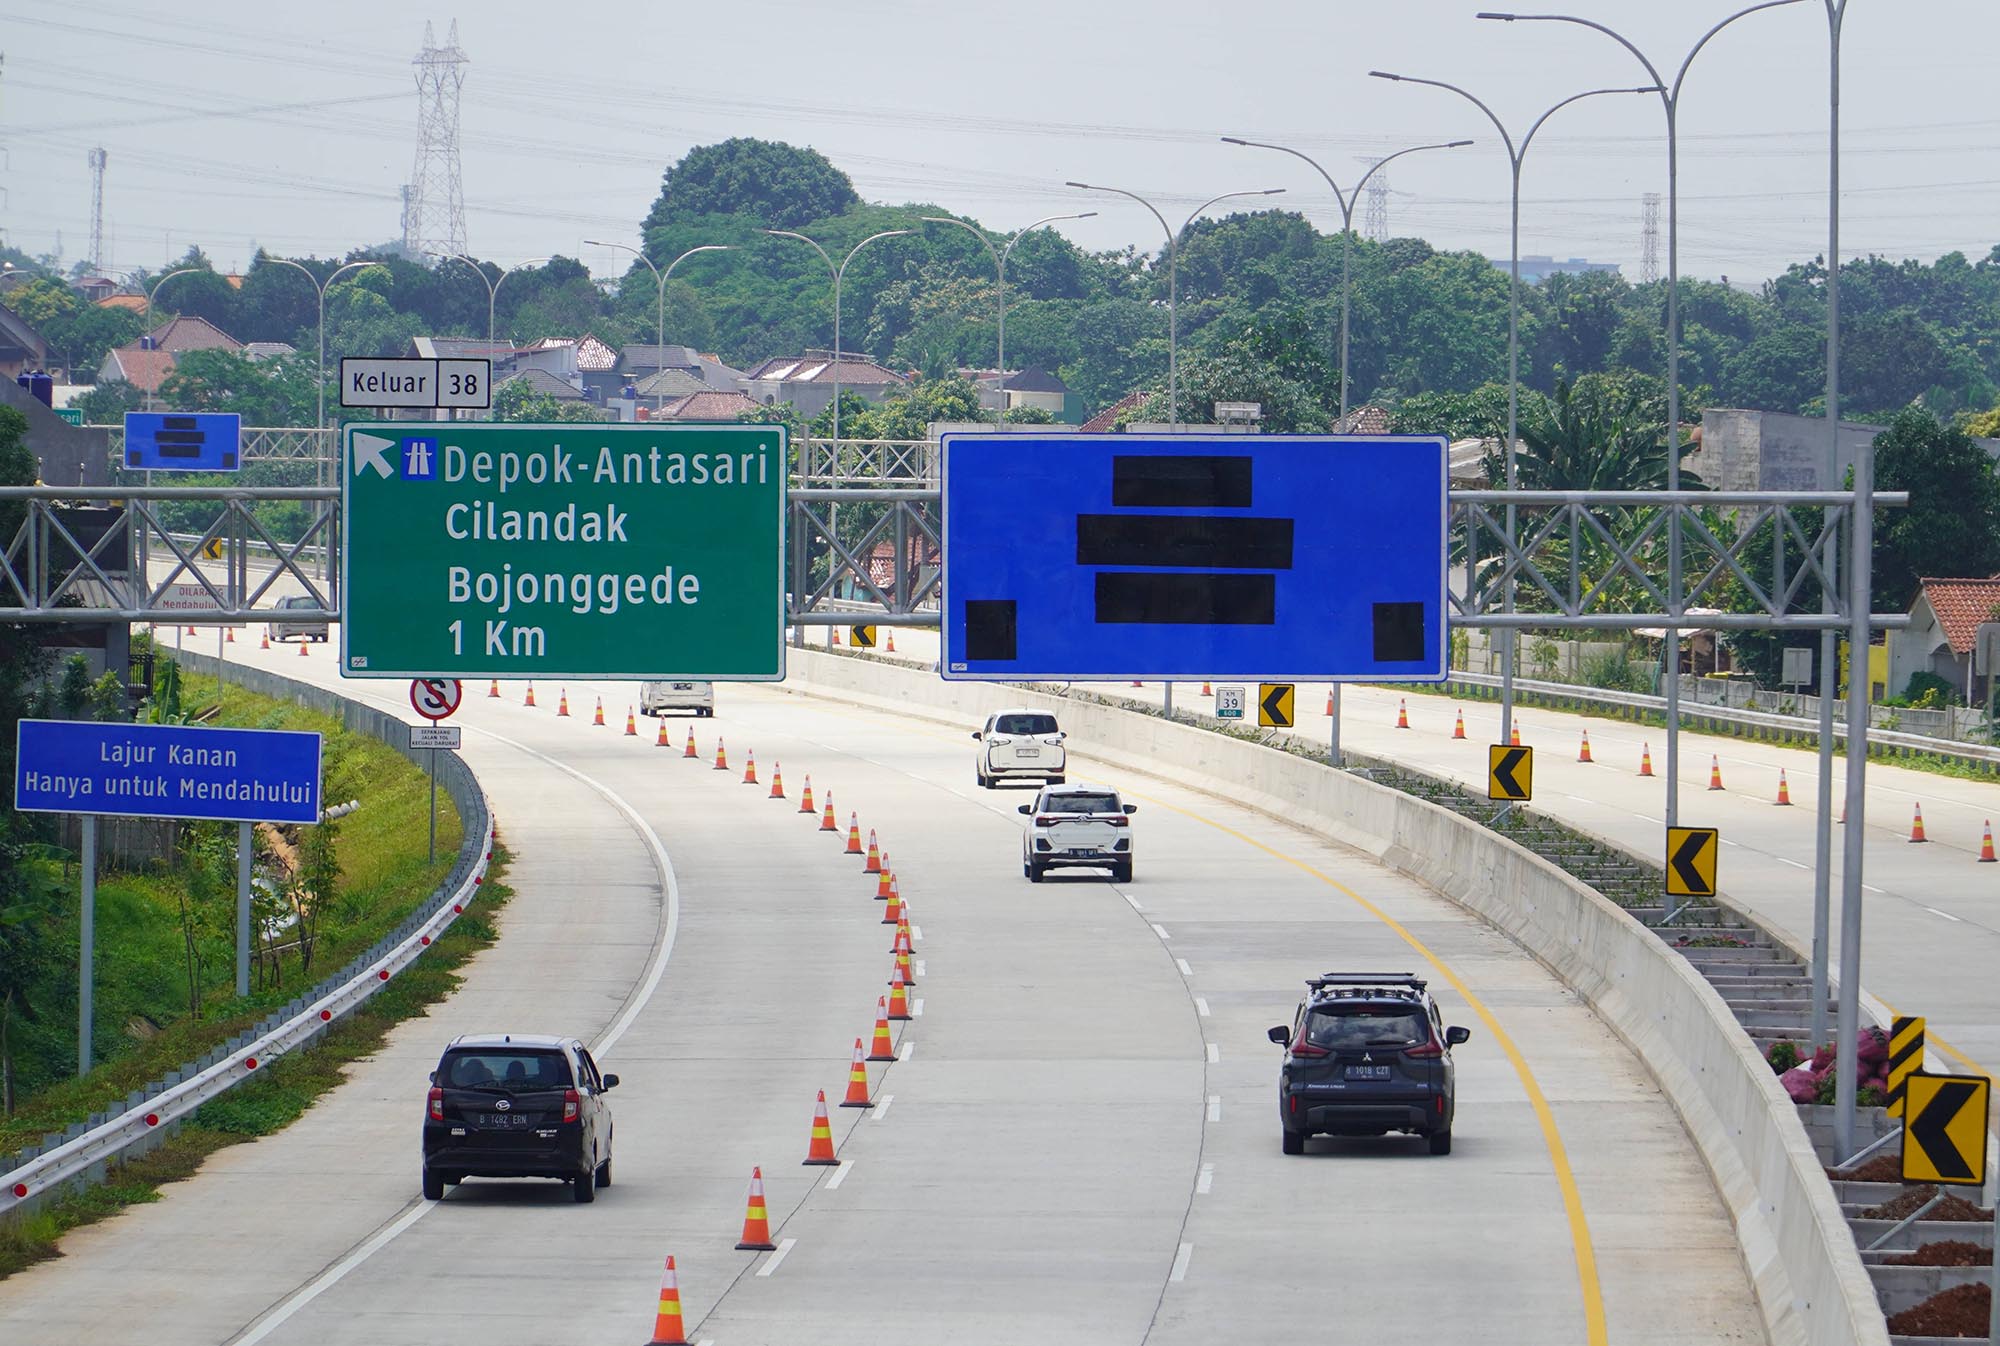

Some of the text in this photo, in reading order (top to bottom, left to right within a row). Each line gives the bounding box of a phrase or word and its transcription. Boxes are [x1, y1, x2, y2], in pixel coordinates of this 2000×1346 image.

[353, 372, 478, 396] Keluar 38
[445, 444, 768, 493] Depok-Antasari
[446, 500, 628, 543] Cilandak
[179, 587, 224, 596] DILARAG
[448, 563, 700, 615] Bojonggede
[449, 620, 545, 657] 1 Km
[1223, 698, 1238, 709] 39
[101, 740, 237, 768] Lajur Kanan
[25, 771, 311, 804] Hanya untuk Mendahului
